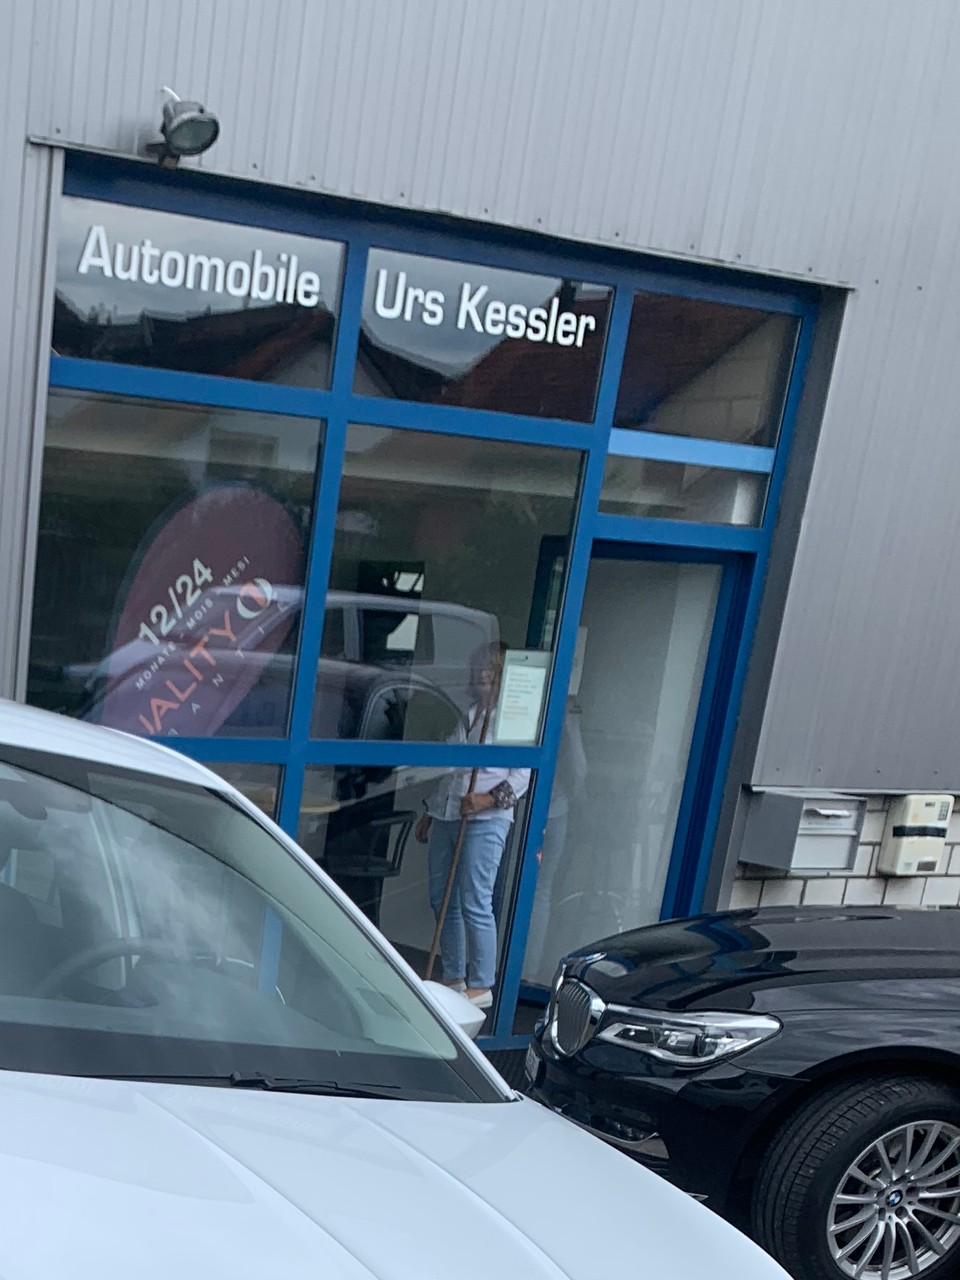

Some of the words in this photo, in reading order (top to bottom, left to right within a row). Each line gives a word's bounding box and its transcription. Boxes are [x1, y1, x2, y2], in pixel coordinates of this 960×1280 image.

[78, 225, 321, 307] Automobile
[375, 269, 445, 326] Urs
[457, 282, 596, 348] Kessler
[138, 558, 214, 646] 12/24
[186, 598, 214, 631] MOIS
[223, 556, 250, 586] MESI
